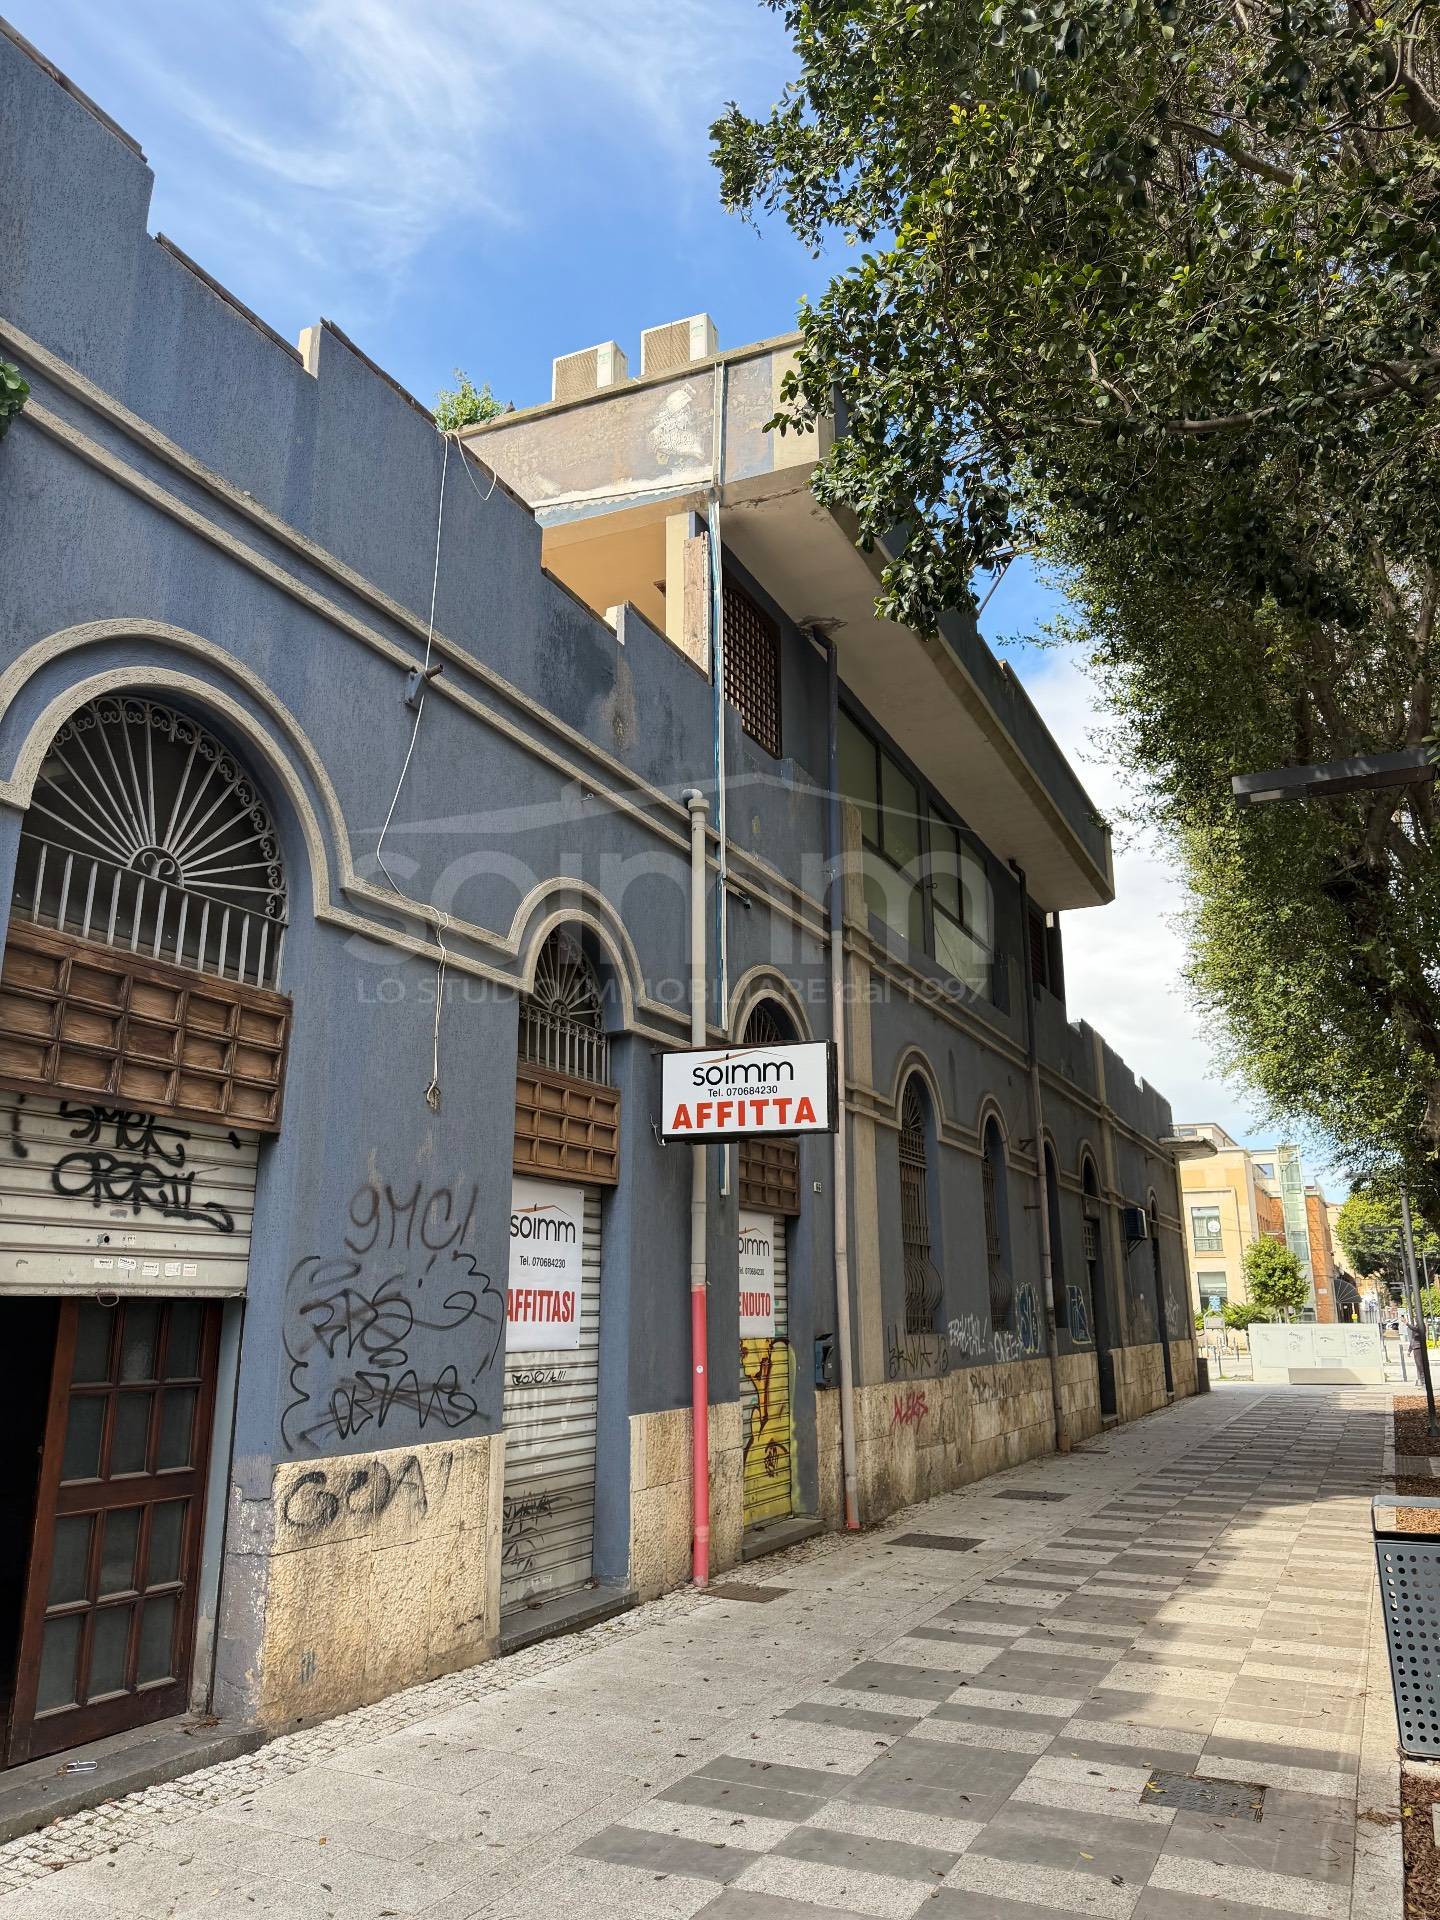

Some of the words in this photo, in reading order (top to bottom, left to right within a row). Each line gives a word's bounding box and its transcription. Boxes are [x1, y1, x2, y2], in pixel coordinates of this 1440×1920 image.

[692, 1060, 794, 1086] soimm
[708, 1088, 724, 1098] Tel.
[726, 1085, 778, 1097] 070684230
[671, 1096, 817, 1130] AFFITTA
[510, 1214, 576, 1243] soimm
[739, 1236, 770, 1256] oimm
[519, 1255, 531, 1266] Tel.
[532, 1256, 566, 1268] 070684230
[506, 1288, 575, 1322] AFFITTASI
[738, 1291, 771, 1317] ENDUTO
